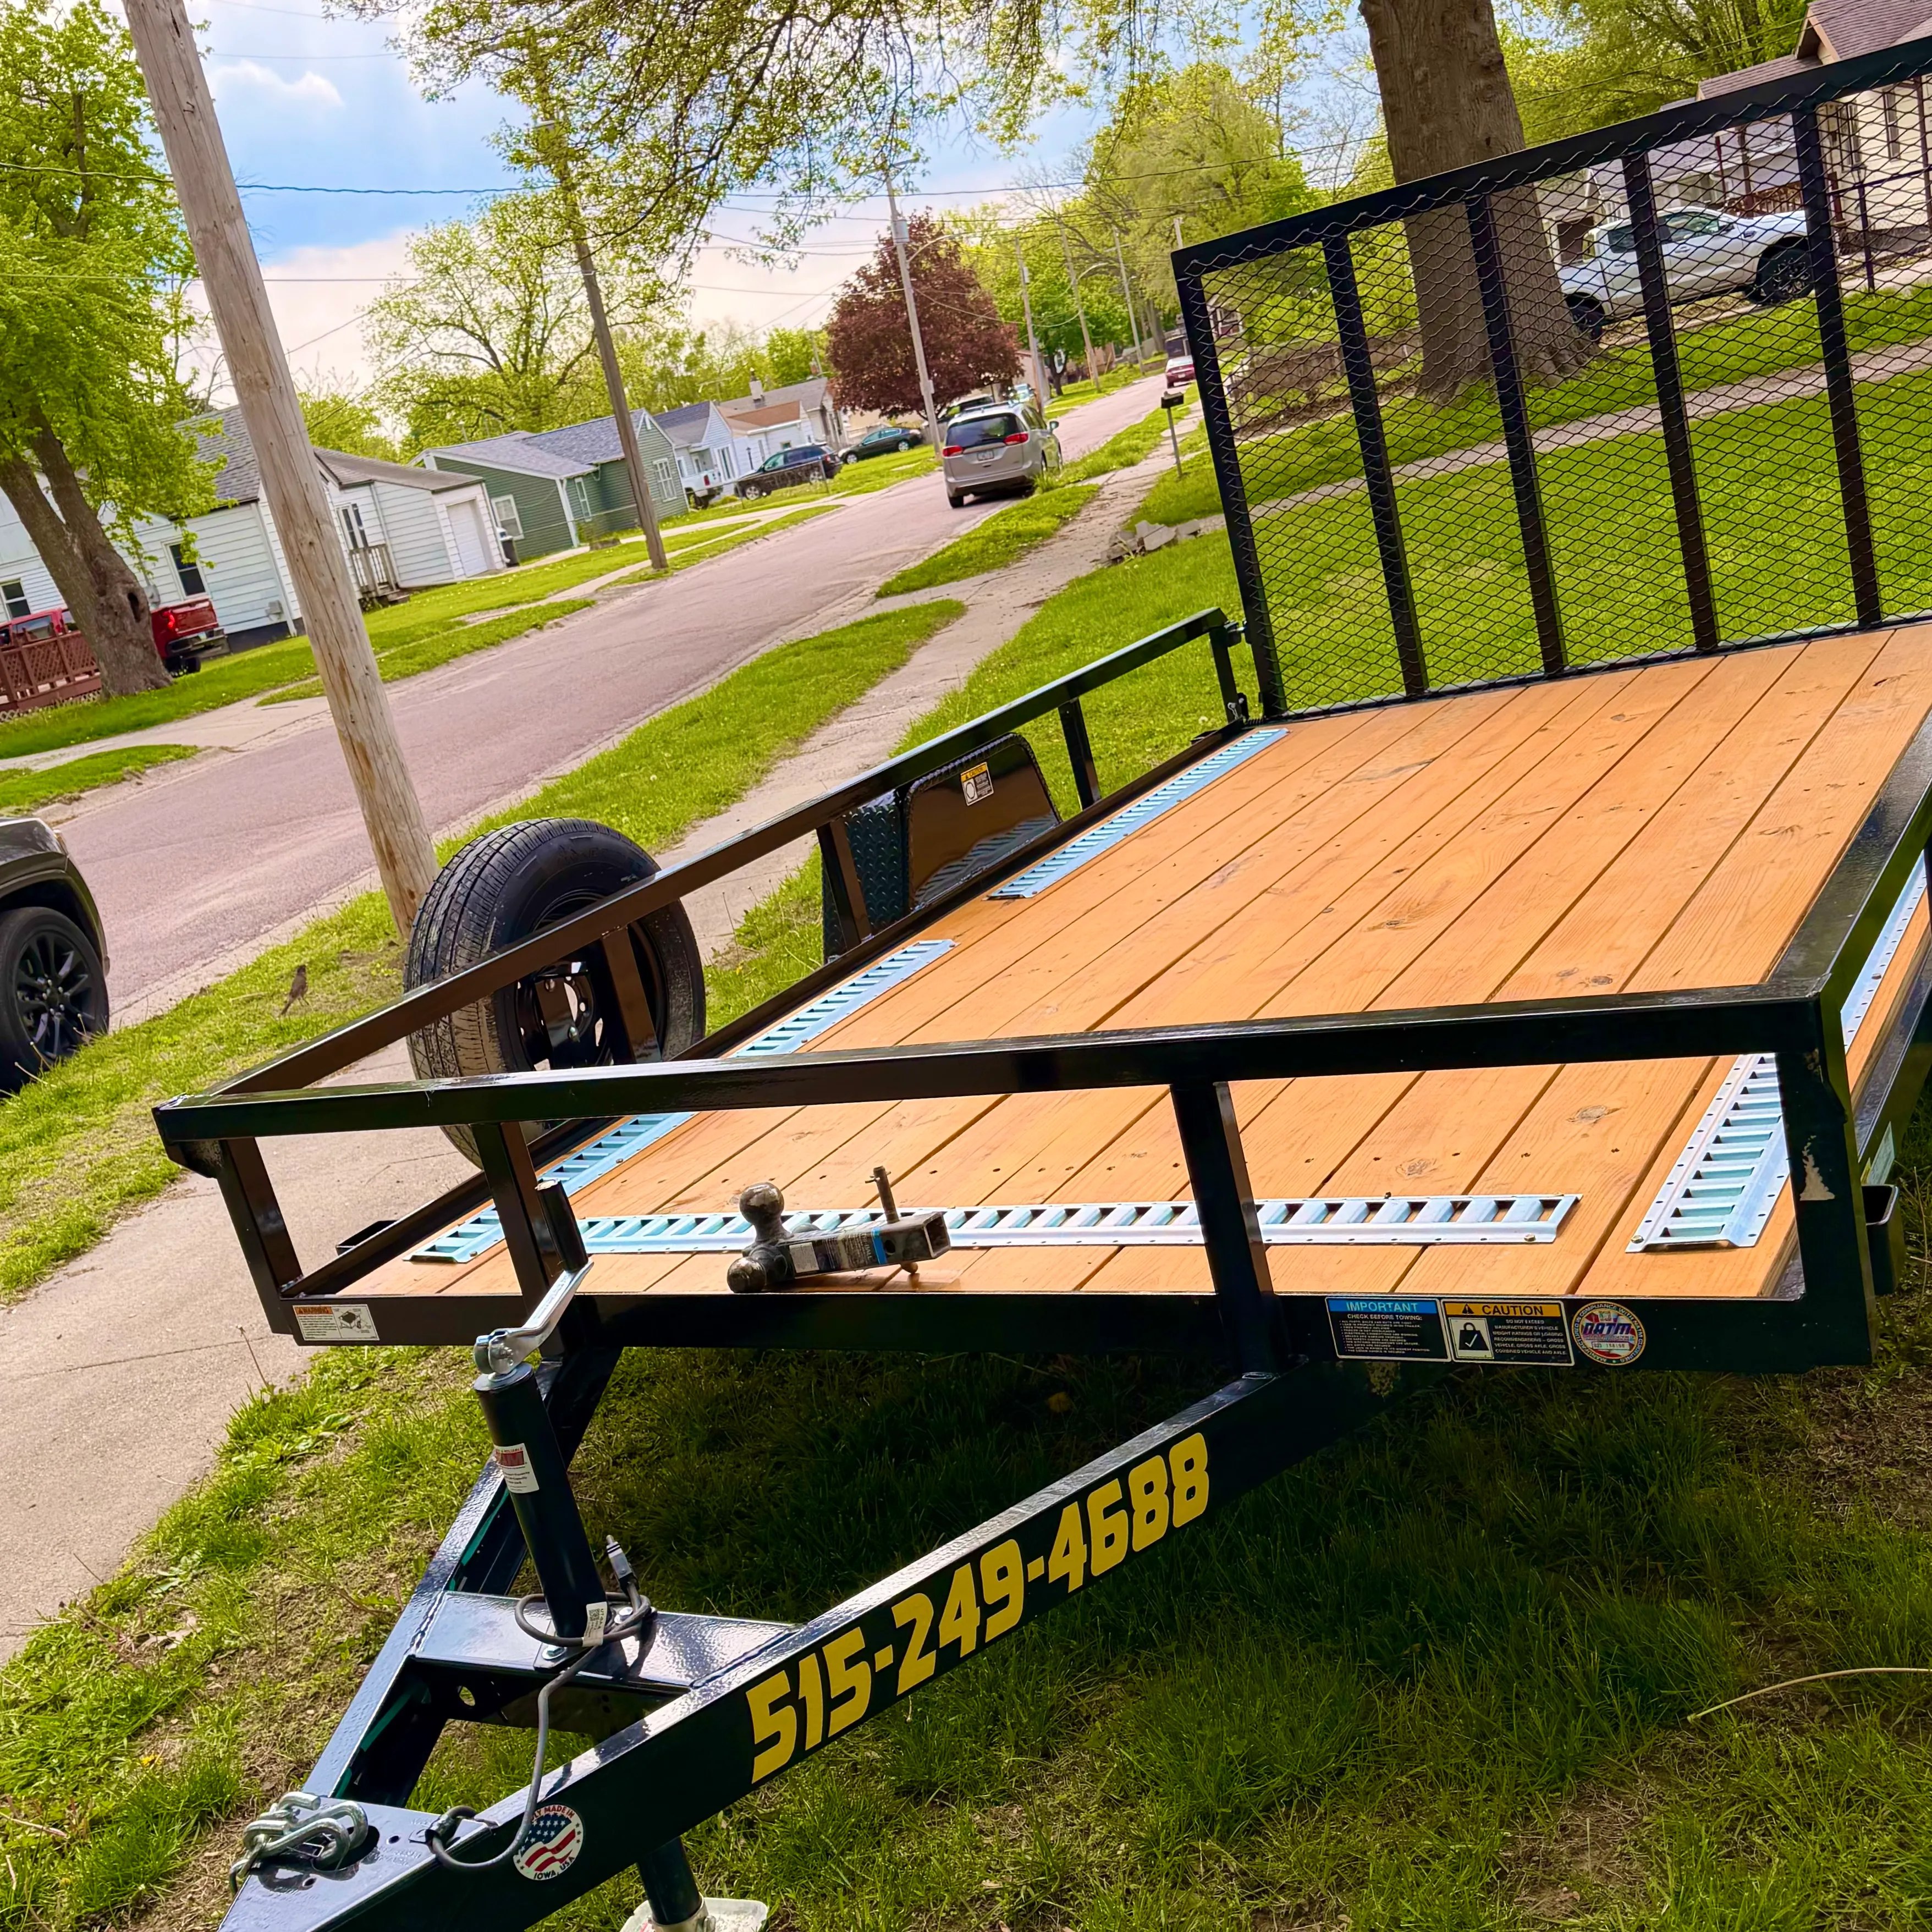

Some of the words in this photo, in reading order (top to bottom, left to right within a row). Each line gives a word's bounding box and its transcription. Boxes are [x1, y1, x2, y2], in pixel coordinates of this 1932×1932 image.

[1346, 1301, 1419, 1312] IMPORTANT
[1482, 1305, 1543, 1315] CAUTION
[1619, 1307, 1634, 1319] WITH
[1583, 1323, 1631, 1335] NATM
[746, 1432, 1209, 1785] 515-249-4688
[544, 1806, 566, 1814] MADE
[566, 1809, 576, 1819] IN
[533, 1869, 559, 1880] IOWA,
[559, 1856, 575, 1870] USA
